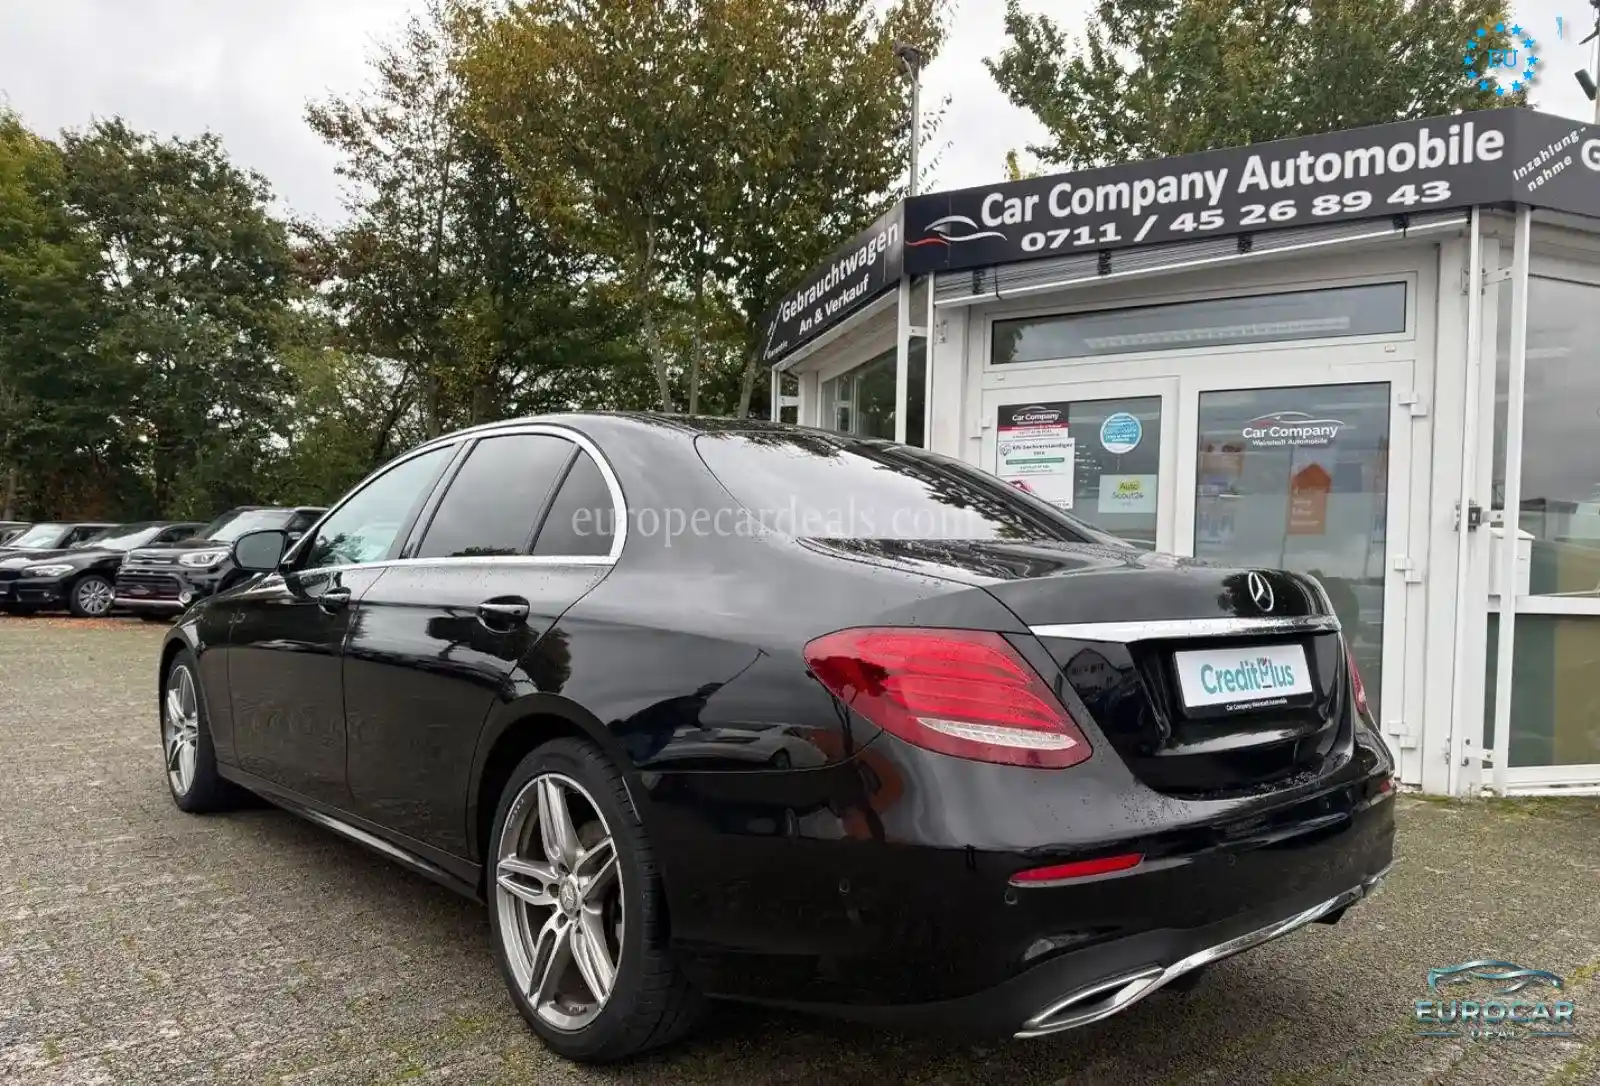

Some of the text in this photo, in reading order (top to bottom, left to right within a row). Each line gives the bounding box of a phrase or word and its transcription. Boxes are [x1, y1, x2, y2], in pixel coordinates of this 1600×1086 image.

[981, 121, 1505, 227] Car Company Automobile
[1527, 155, 1572, 192] nahme
[1020, 180, 1452, 252] 0711 / 45 26 89 43
[781, 222, 898, 323] Gebrauchtwagen
[799, 272, 870, 335] An & Verkauf
[1025, 413, 1060, 421] Company
[1242, 424, 1339, 439] Car Company
[1288, 437, 1328, 445] Automobile
[1119, 482, 1139, 490] Auto
